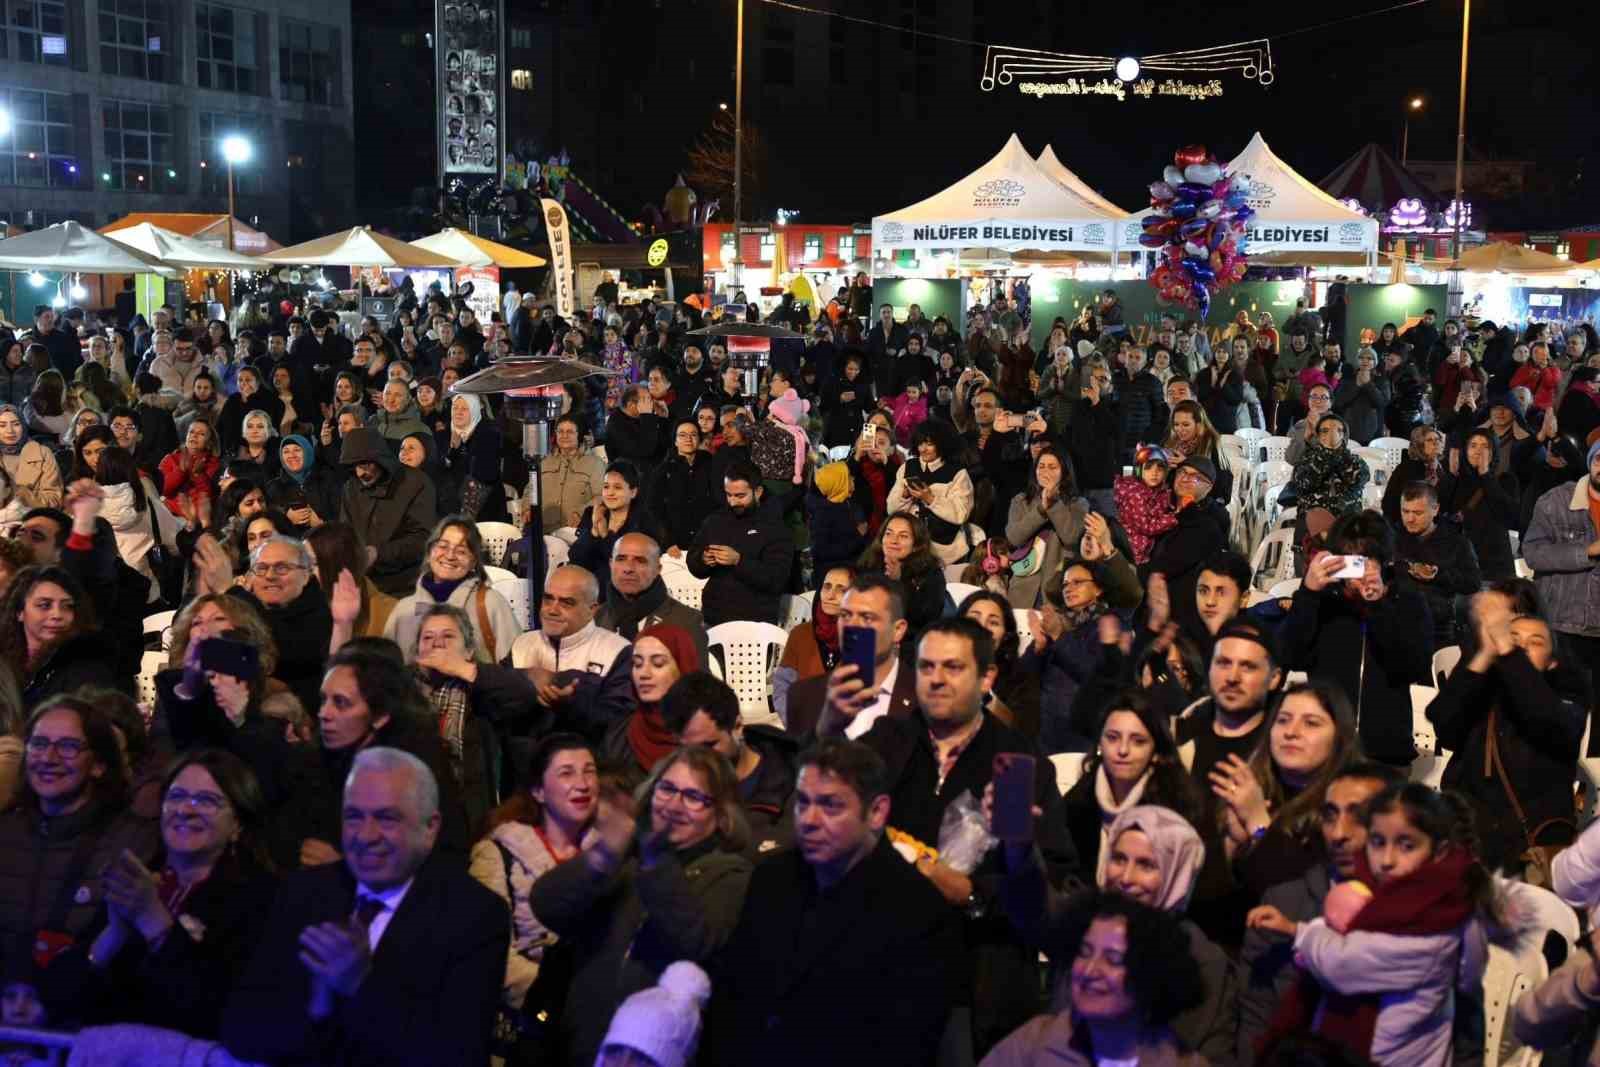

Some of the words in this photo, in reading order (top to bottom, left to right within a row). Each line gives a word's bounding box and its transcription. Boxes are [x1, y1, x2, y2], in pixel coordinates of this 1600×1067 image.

[913, 225, 978, 241] NİLÜFER
[983, 225, 1074, 242] BELEDİYESİ
[1246, 226, 1329, 242] ELEDİYESİ
